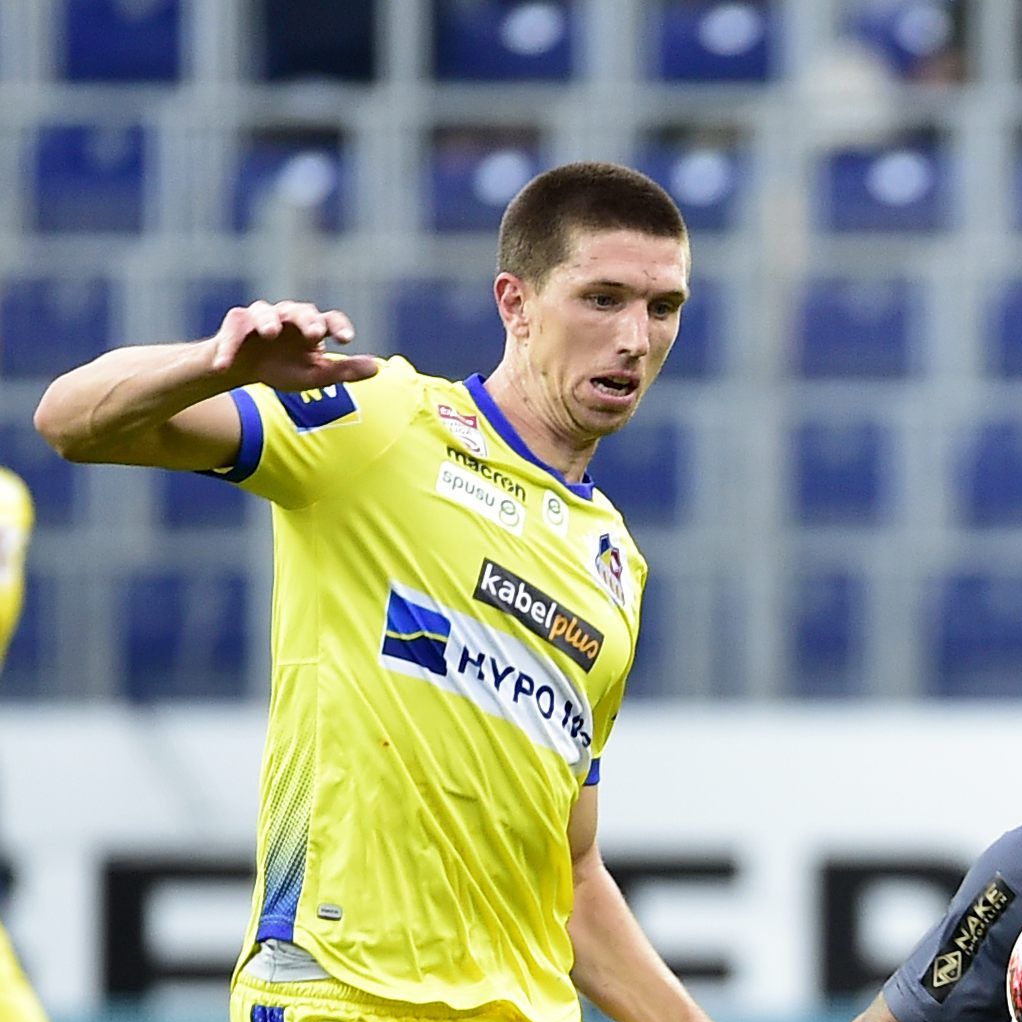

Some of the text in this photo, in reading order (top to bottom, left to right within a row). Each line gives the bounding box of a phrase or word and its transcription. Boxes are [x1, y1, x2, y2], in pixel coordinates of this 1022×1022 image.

[442, 470, 496, 507] spusu
[446, 445, 526, 503] macron
[480, 562, 600, 660] kabelplus
[457, 645, 555, 720] HYPO
[953, 882, 1002, 952] NAKE
